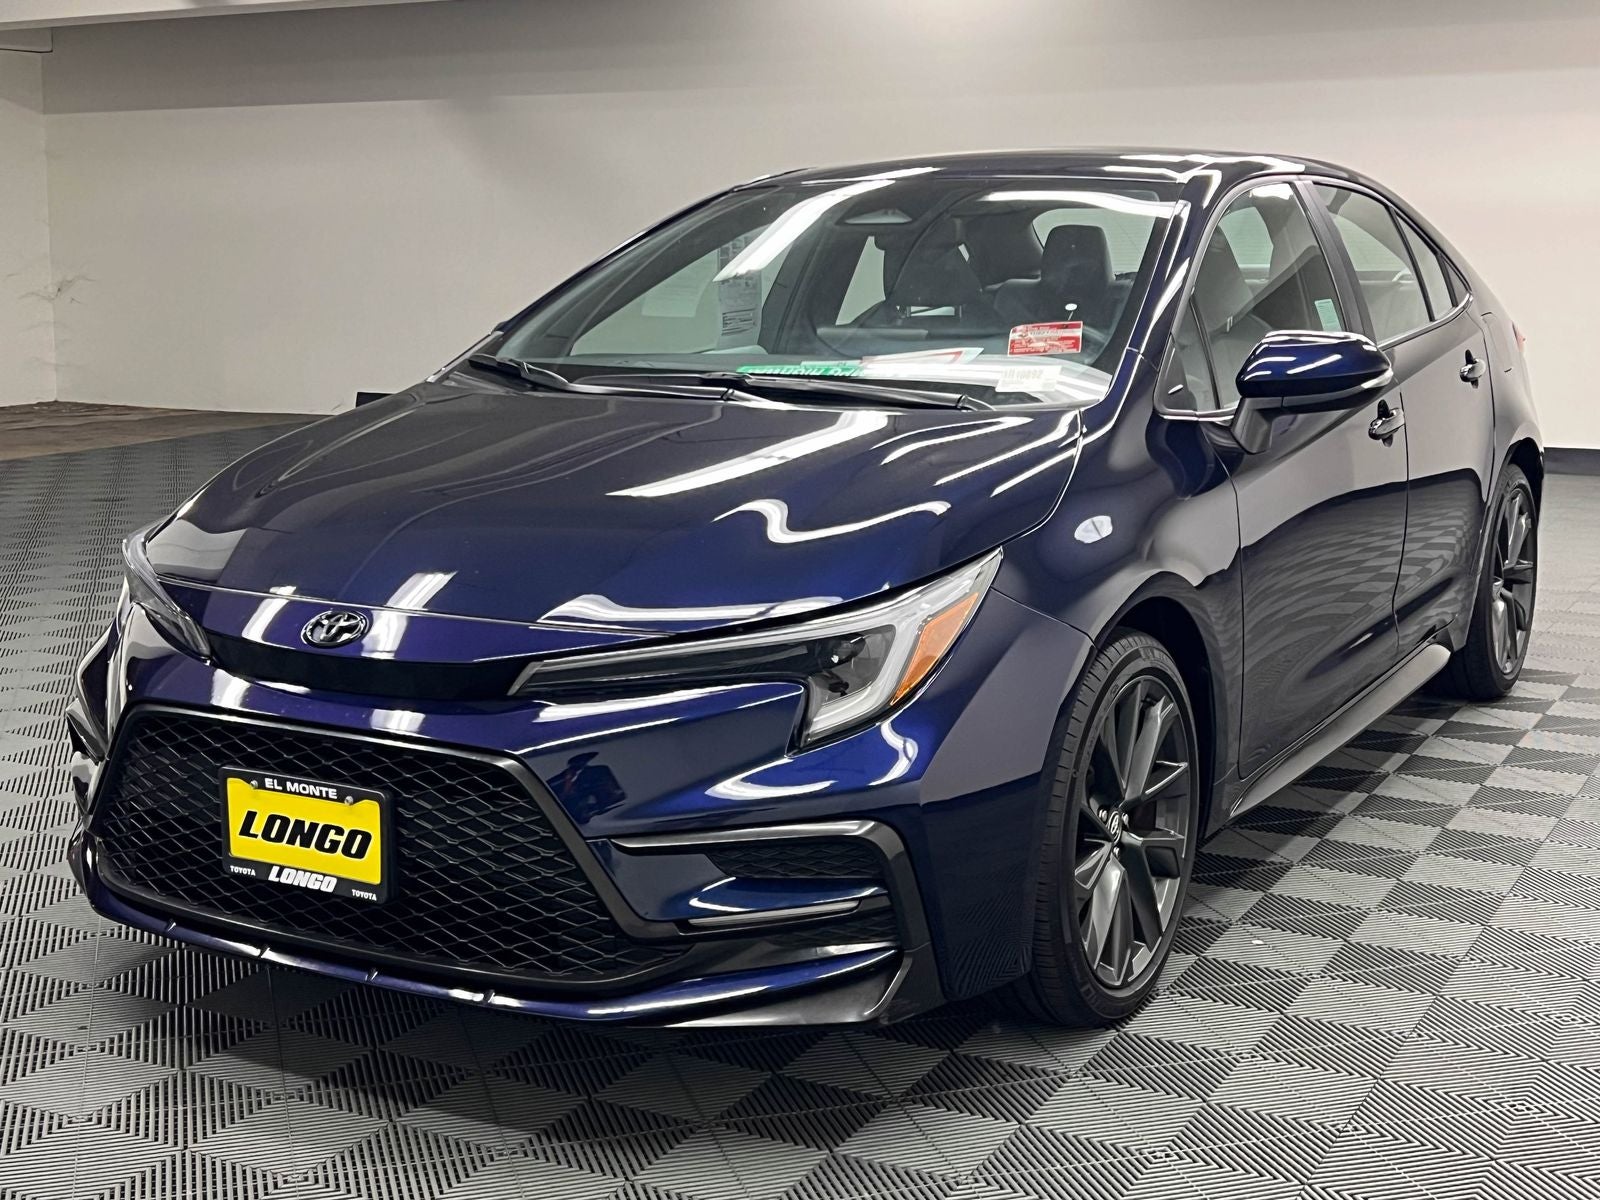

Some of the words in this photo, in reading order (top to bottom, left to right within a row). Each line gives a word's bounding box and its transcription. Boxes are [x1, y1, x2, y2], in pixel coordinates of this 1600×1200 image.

[264, 778, 282, 790] EL
[286, 782, 337, 799] MONTE
[238, 810, 372, 860] LONGO
[230, 865, 256, 876] TOYOTA
[268, 866, 337, 893] LONGO
[352, 889, 377, 901] TOYOTA
